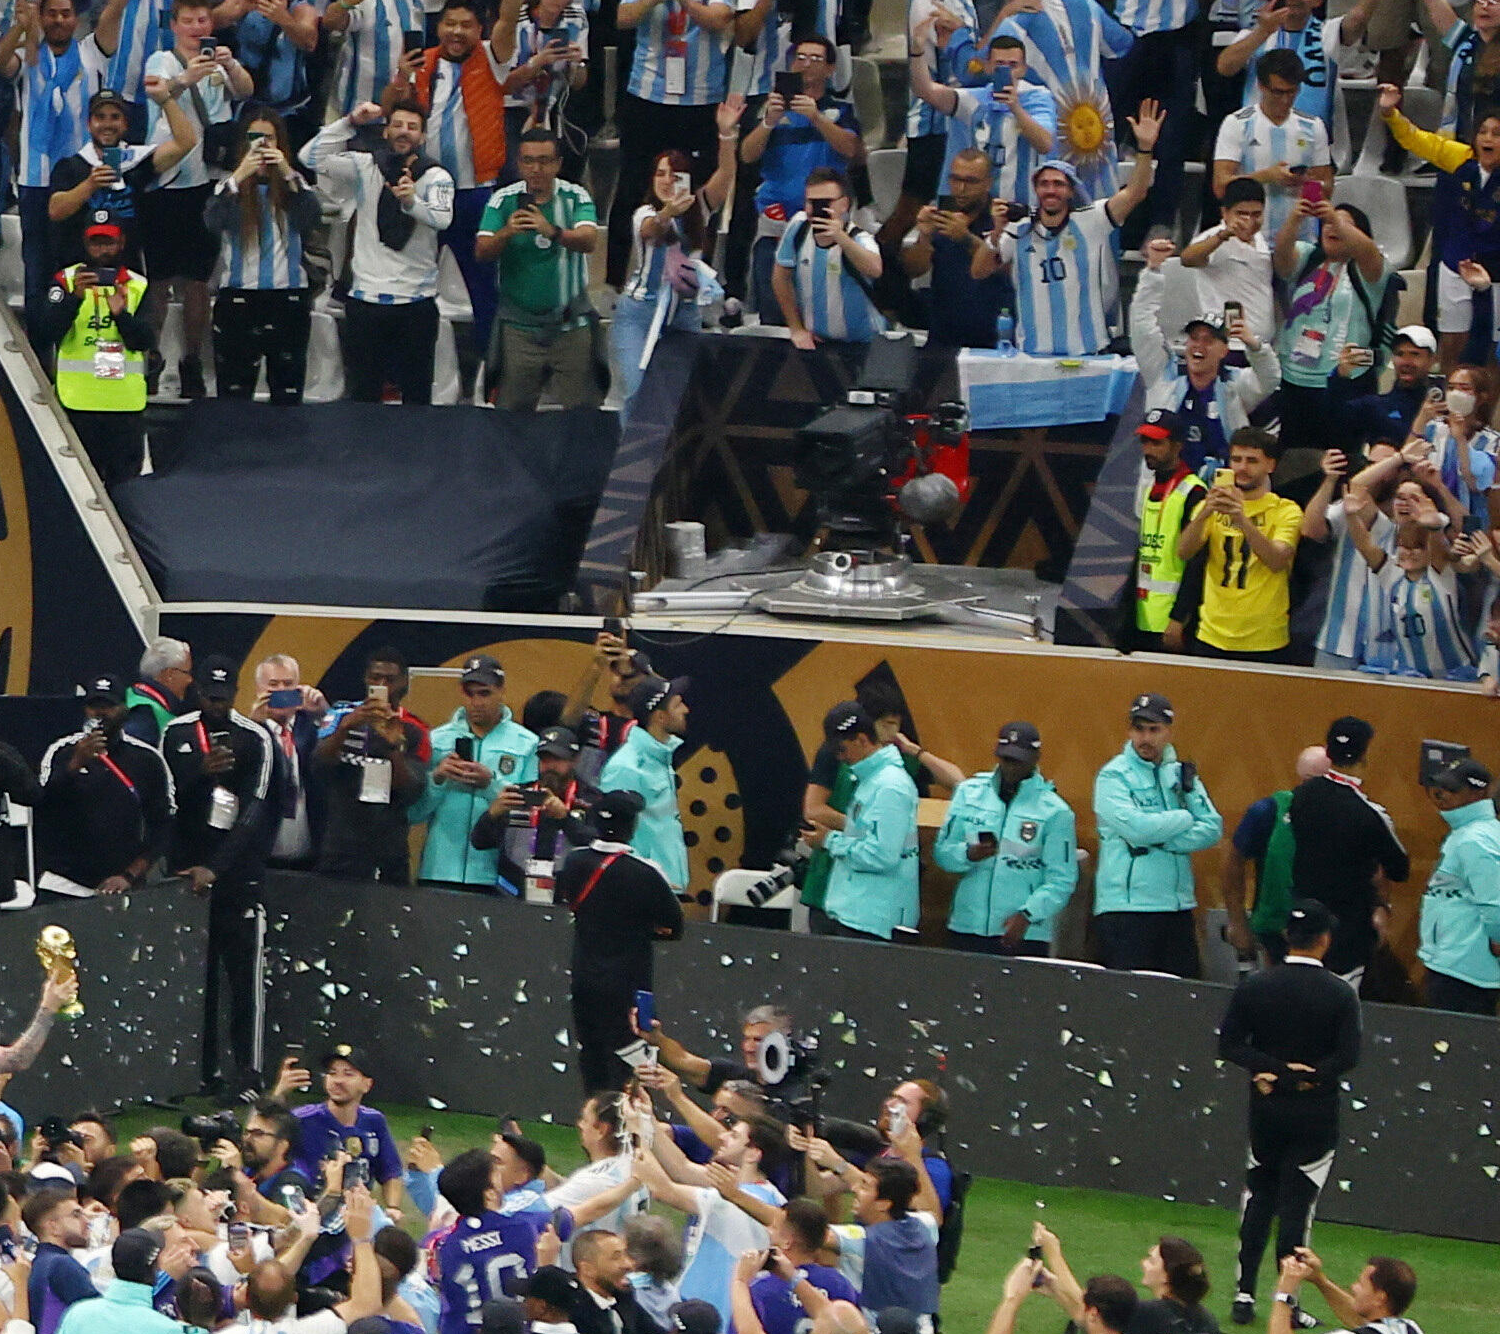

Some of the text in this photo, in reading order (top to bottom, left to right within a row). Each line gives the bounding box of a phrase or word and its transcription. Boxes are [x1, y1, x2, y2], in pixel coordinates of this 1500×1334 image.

[1040, 255, 1066, 282] 10
[1223, 537, 1250, 589] 11
[463, 1233, 501, 1253] MESSI
